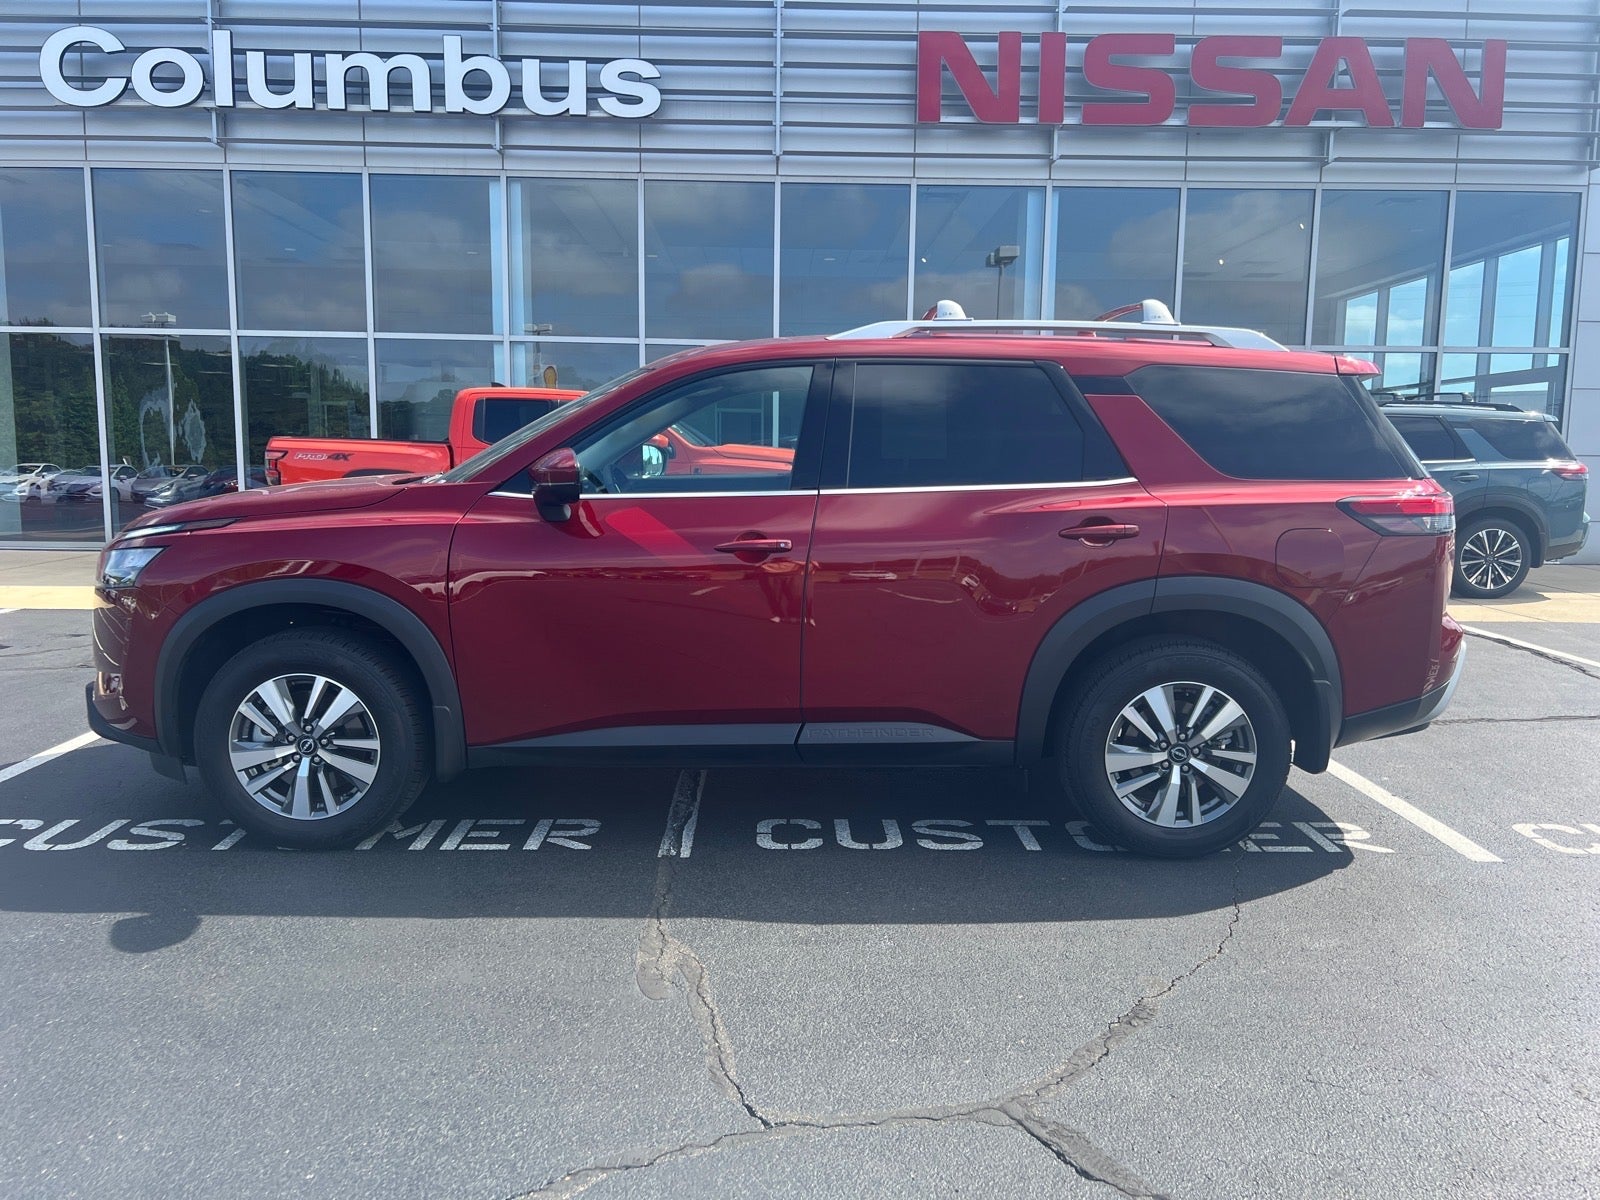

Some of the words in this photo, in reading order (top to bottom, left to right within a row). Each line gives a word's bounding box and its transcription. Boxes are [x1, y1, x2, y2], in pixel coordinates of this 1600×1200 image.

[39, 25, 662, 118] Columbus
[916, 30, 1508, 130] NISSAN
[806, 727, 936, 738] PATHFINDER
